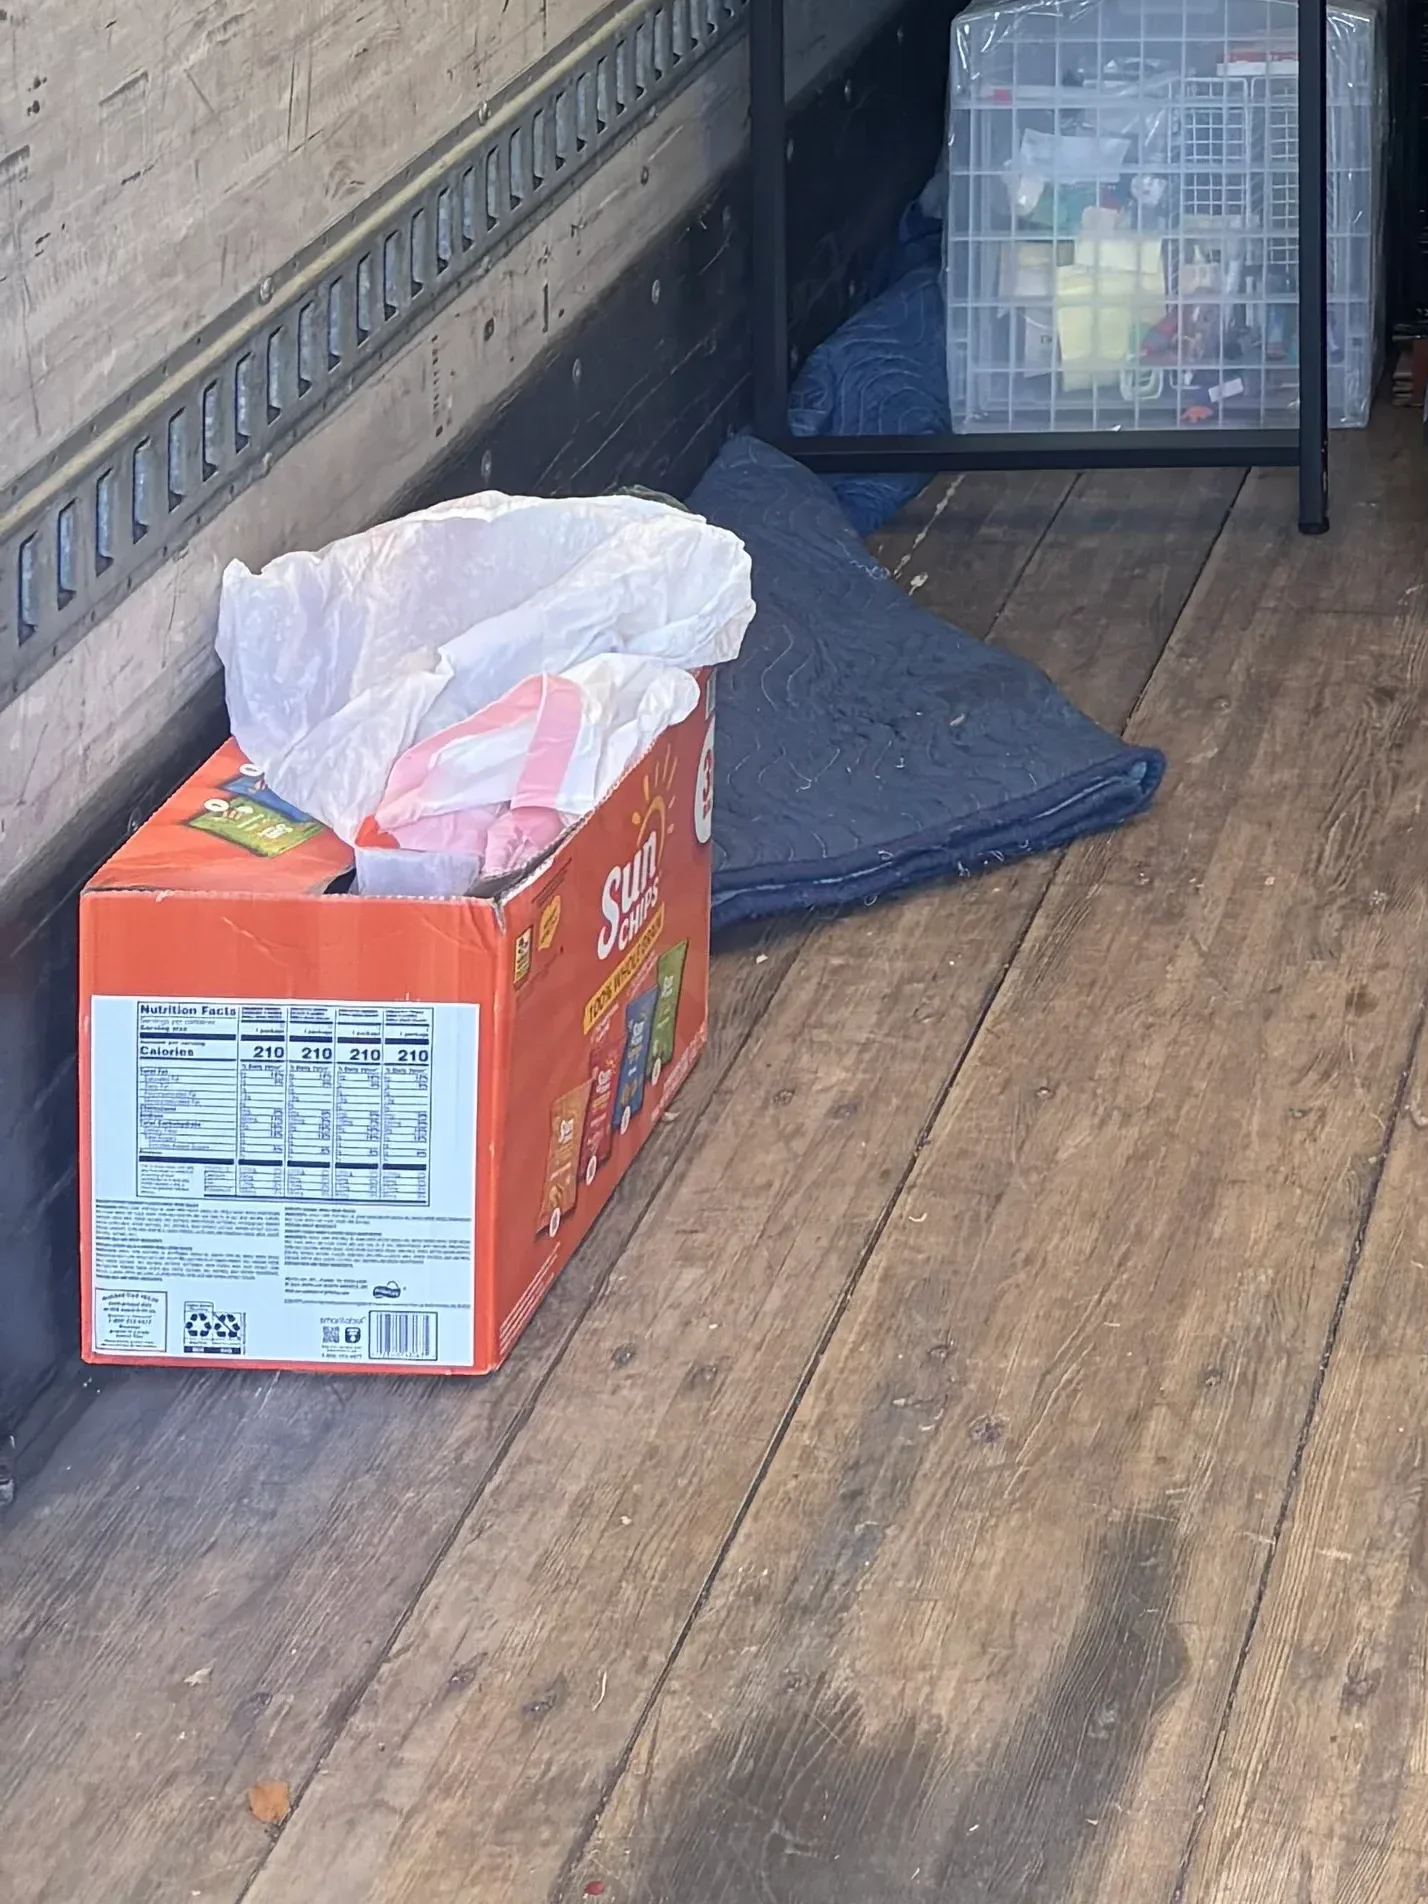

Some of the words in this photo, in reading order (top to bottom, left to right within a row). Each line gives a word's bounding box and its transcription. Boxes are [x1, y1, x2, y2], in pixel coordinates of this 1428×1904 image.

[597, 830, 657, 961] Sun
[618, 876, 660, 952] CHIPS
[140, 1004, 197, 1015] Nutrition
[140, 1046, 195, 1057] Calories
[253, 1046, 284, 1059] 210
[302, 1047, 332, 1060] 210
[350, 1049, 381, 1061] 210
[398, 1050, 429, 1062] 210
